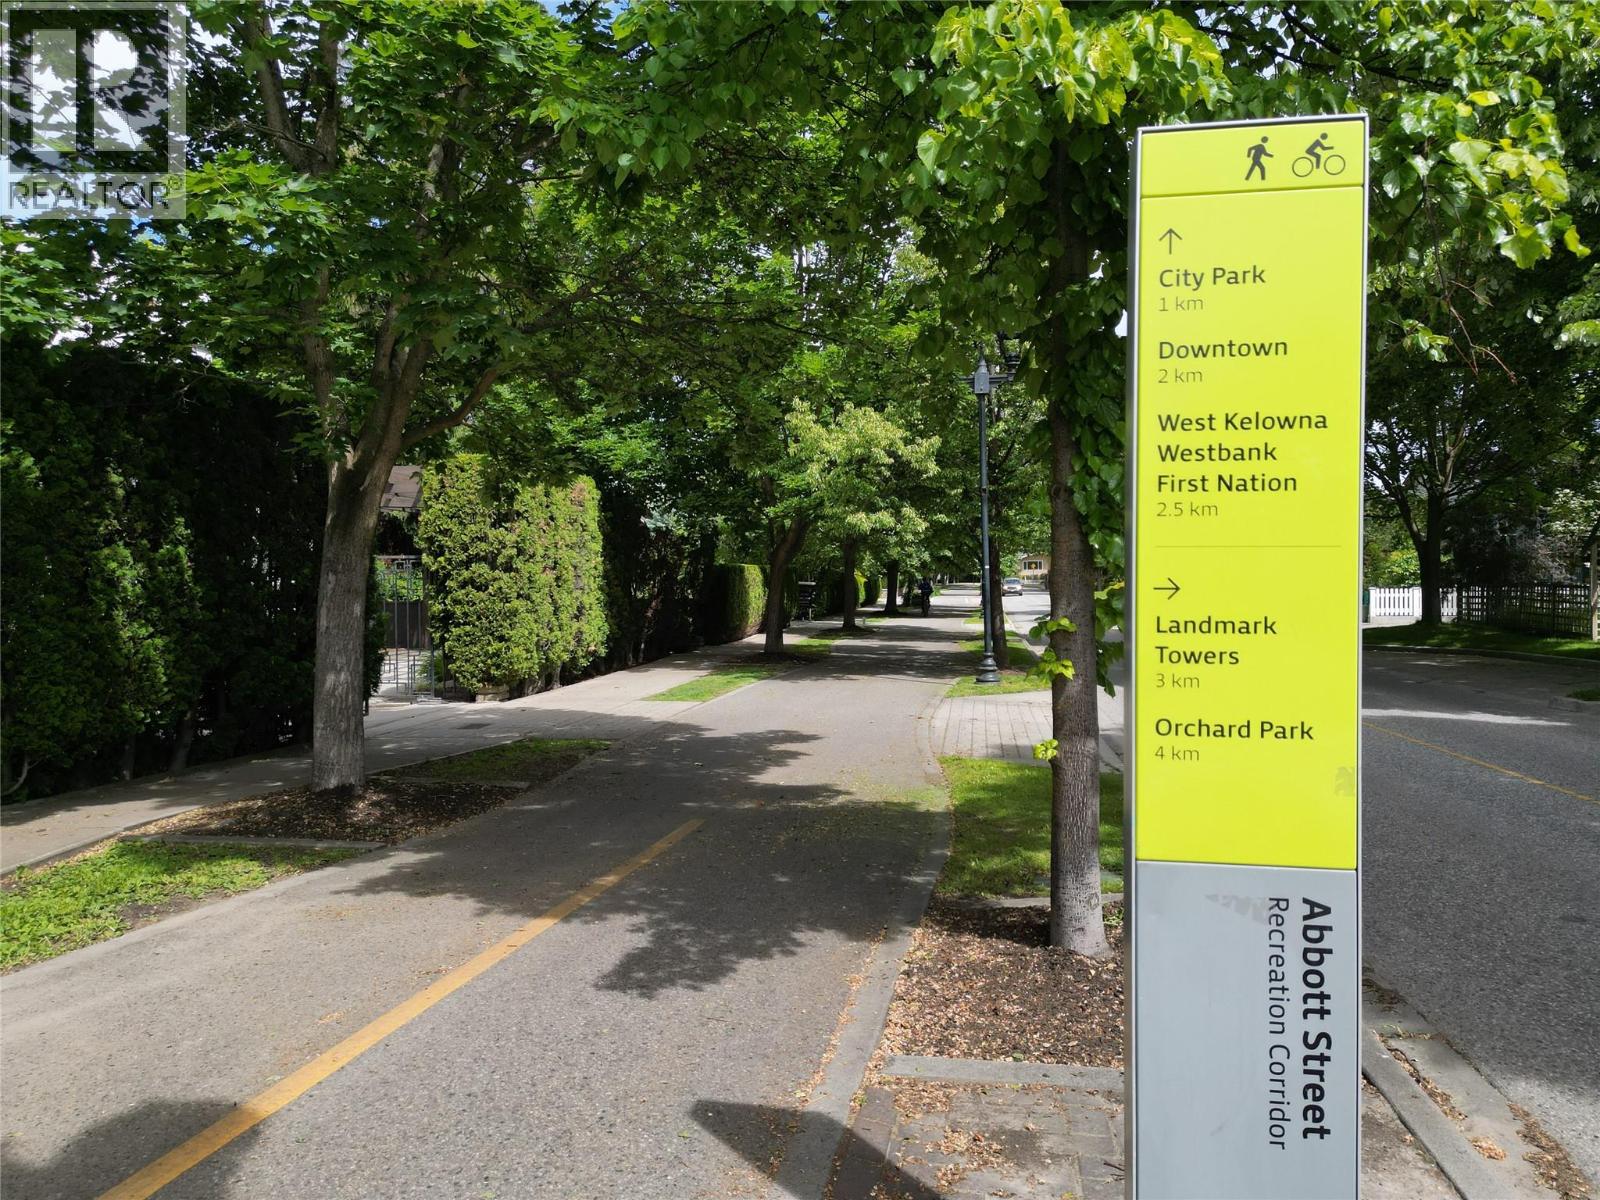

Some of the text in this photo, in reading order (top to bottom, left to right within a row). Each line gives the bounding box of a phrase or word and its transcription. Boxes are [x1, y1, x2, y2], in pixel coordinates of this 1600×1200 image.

[1158, 264, 1267, 292] City Park
[1158, 296, 1204, 312] 1 km
[1158, 339, 1288, 360] Downtown
[1157, 367, 1203, 384] 2 km
[1157, 410, 1329, 433] West Kelowna
[1157, 440, 1278, 463] Westbank
[1157, 472, 1298, 494] First Nation
[1156, 501, 1219, 517] 2.5 km
[1155, 614, 1278, 636] Landmark
[1155, 645, 1240, 666] Towers
[1156, 672, 1200, 689] 3 km
[1154, 717, 1315, 741] Orchard Park
[1154, 745, 1200, 761] 4 km
[1267, 896, 1292, 1151] Recreation Corridor
[1301, 896, 1334, 1141] Abbott Street
